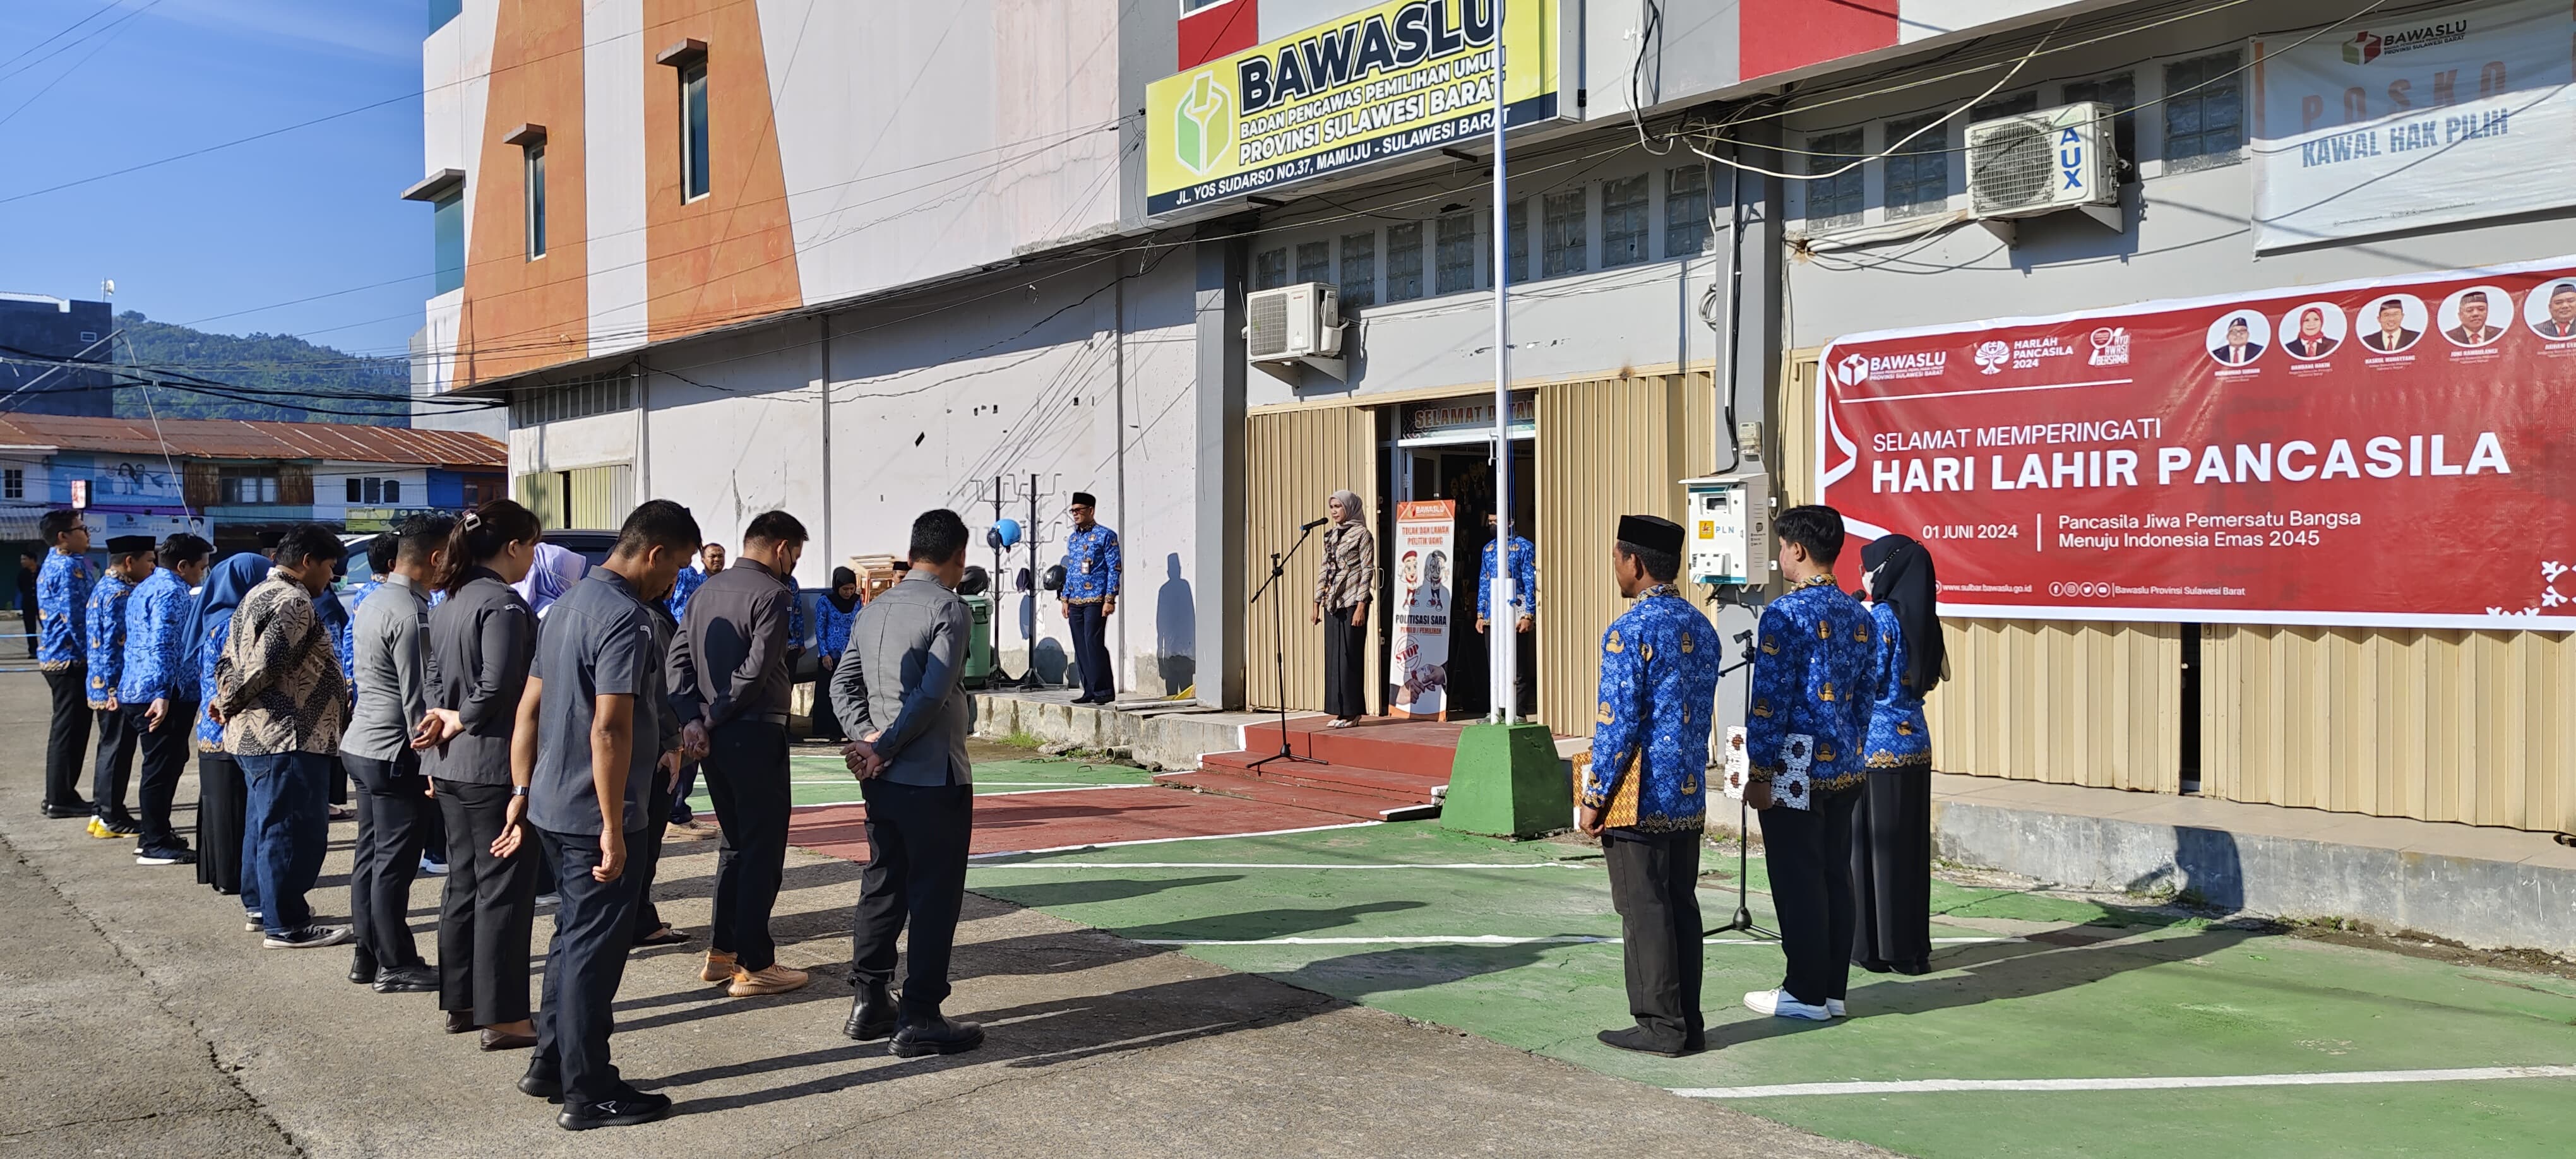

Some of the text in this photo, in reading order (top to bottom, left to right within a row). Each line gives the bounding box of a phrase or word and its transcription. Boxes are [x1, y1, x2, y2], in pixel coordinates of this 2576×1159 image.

[2383, 20, 2467, 46] BAWASLU
[2384, 46, 2411, 56] PROVINSI
[2412, 40, 2443, 51] SULAWESI
[2444, 35, 2465, 44] BARAT
[1237, 0, 1505, 116] BAWASLU
[1240, 109, 1285, 140] BADAN
[1288, 86, 1362, 126] PENGAWAS
[1365, 61, 1450, 103] PEMILIHAN
[1239, 122, 1320, 166] PROVINSI
[1323, 93, 1425, 143] SULAWESI
[2302, 108, 2509, 168] KAWAL HAK PILIH
[1176, 191, 1191, 205] JL.
[1194, 182, 1216, 200] YOS
[1218, 168, 1274, 194] SUDARSO
[1277, 158, 1313, 181] NO.37,
[1316, 142, 1371, 170] MAMUJU
[1383, 121, 1455, 154] SULAWESI
[2060, 127, 2082, 190] AUX
[2013, 346, 2073, 359] PANCASILA
[2014, 337, 2058, 350] HARLAH
[1870, 351, 1946, 371] BAWASLU
[2013, 358, 2039, 369] 2024
[1869, 372, 1895, 381] PROVINSI
[1895, 370, 1923, 379] SULAWESI
[1924, 369, 1943, 377] BARAT
[1415, 406, 1482, 429] SELAMAT
[1873, 418, 2161, 452] SELAMAT MEMPERINGATI
[1873, 431, 2510, 493] HARI LAHIR PANCASILA
[2058, 511, 2361, 530] Pancasila Jiwa Pemersatu Bangsa
[1923, 525, 2018, 540] 01 JUNI 2024
[2058, 530, 2320, 552] Menuju Indonesia Emas 2045
[1943, 584, 2032, 593] www.sulbar.bawaslu.go.id
[2115, 586, 2245, 595] Bawaslu Provinsi Sulawesi Barat
[1395, 614, 1446, 625] POLITISASI SARA
[1395, 644, 1419, 663] STOP
